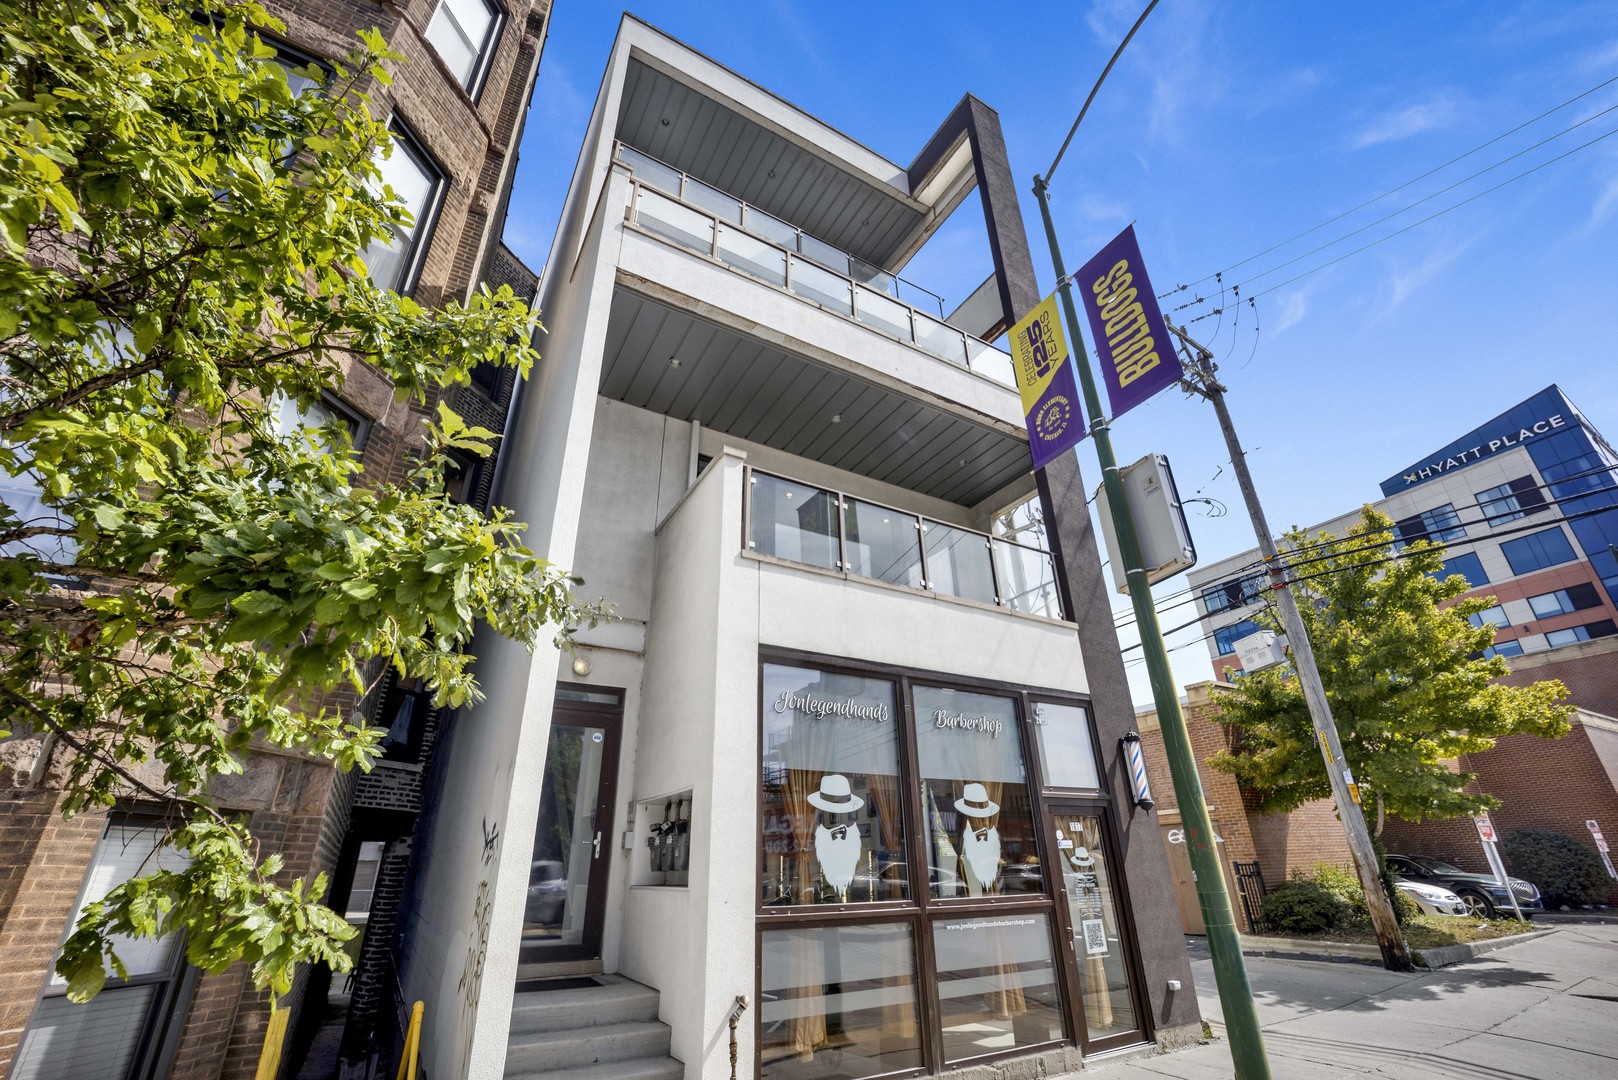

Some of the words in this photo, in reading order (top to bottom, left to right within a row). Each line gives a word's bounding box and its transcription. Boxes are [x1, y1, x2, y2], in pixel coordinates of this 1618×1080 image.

[1026, 319, 1051, 379] 125
[1040, 310, 1059, 369] YEARS
[1093, 259, 1160, 388] BULLDOGS
[1018, 330, 1037, 387] CELEBRATING
[1418, 447, 1481, 480] HYATT
[1488, 414, 1565, 452] PLACE
[774, 690, 888, 722] Jonlegendhands
[934, 709, 1002, 738] Barbershop
